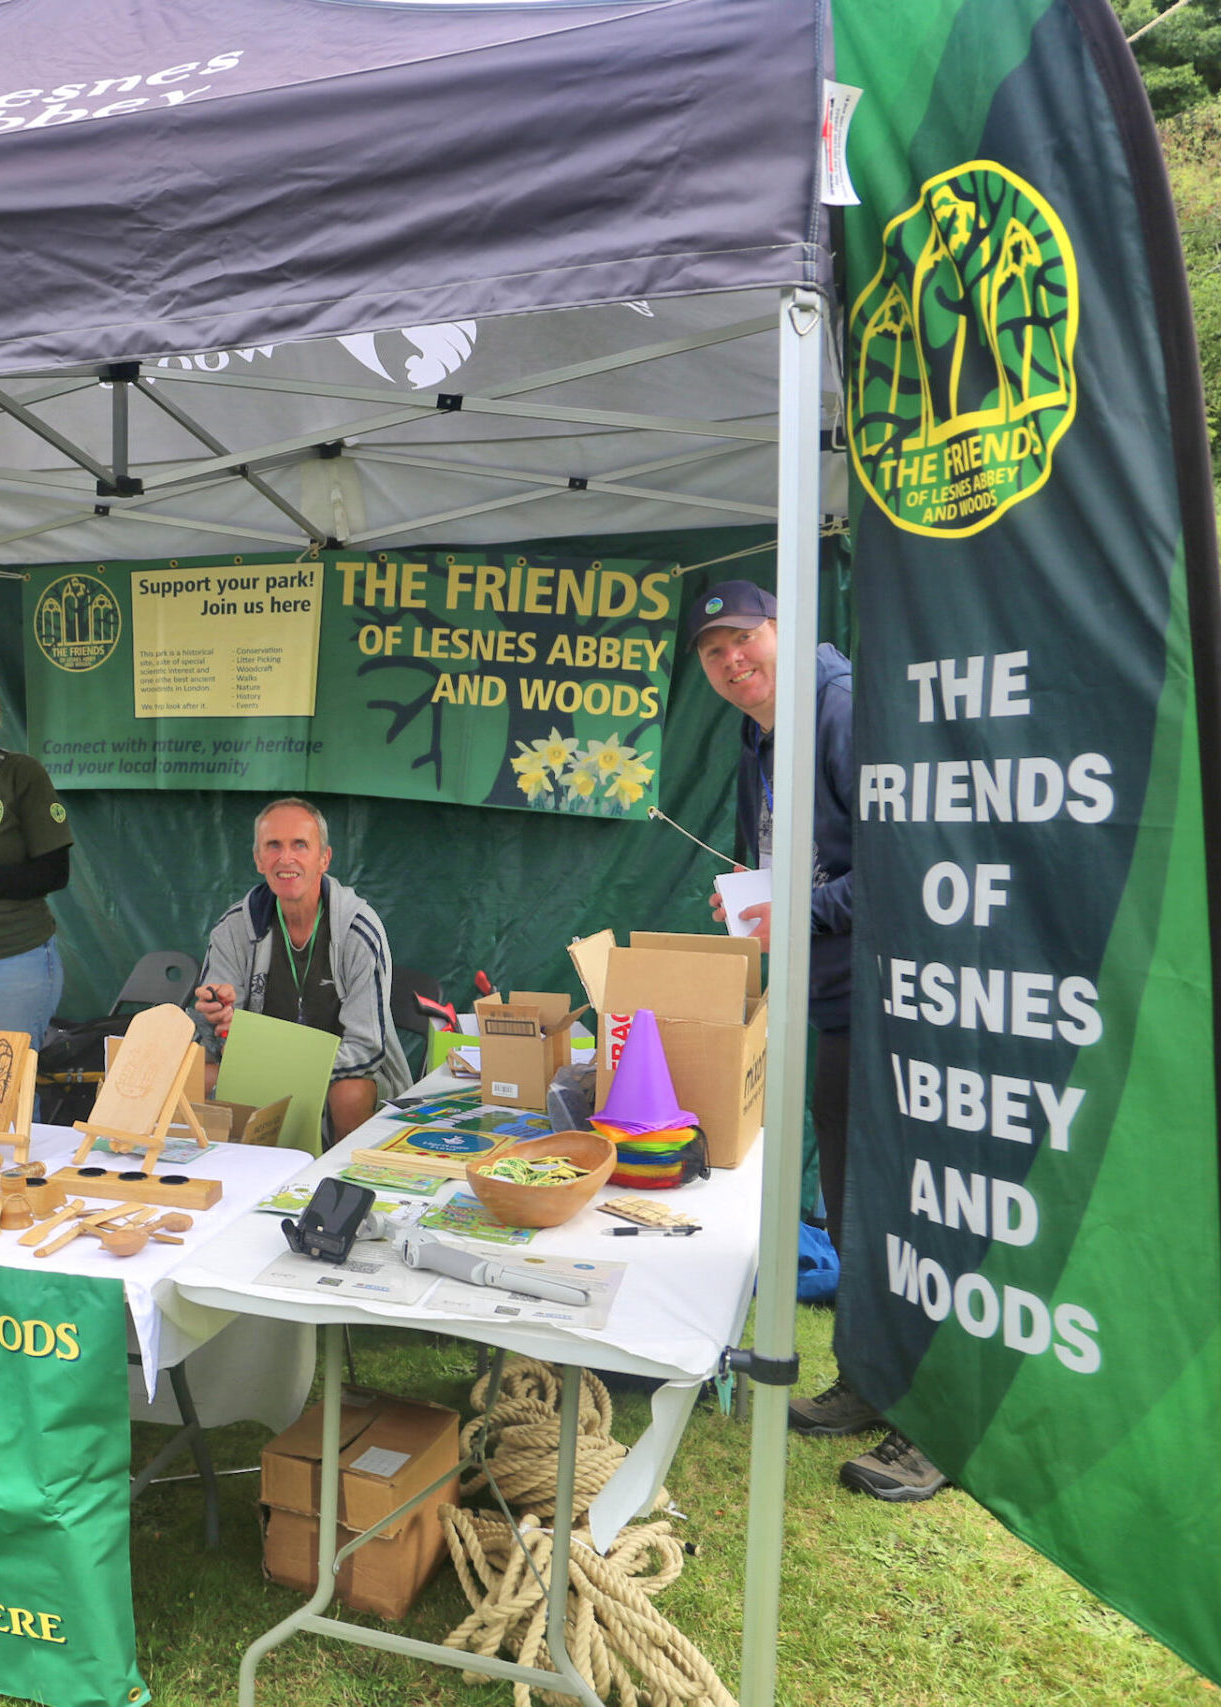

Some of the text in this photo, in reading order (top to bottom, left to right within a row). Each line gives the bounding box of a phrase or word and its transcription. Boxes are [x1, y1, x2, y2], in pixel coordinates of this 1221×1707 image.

[880, 420, 1043, 491] THE FRIENDS
[906, 466, 1019, 507] OF LESNES ABBEY
[922, 490, 998, 523] AND WOODS
[139, 571, 315, 598] Support your park!
[201, 596, 311, 616] Join us here
[335, 562, 671, 621] THE FRIENDS
[358, 625, 668, 673] OF LESNES ABBEY
[431, 673, 659, 719] AND WOODS
[907, 650, 1031, 723] THE
[42, 738, 107, 754] Connect
[111, 737, 147, 753] with
[212, 740, 252, 756] your
[77, 761, 114, 776] your
[118, 758, 157, 774] local
[859, 752, 1115, 824] FRIENDS
[922, 860, 1011, 927] OF
[910, 1158, 1040, 1247] AND
[886, 1232, 1103, 1374] WOODS
